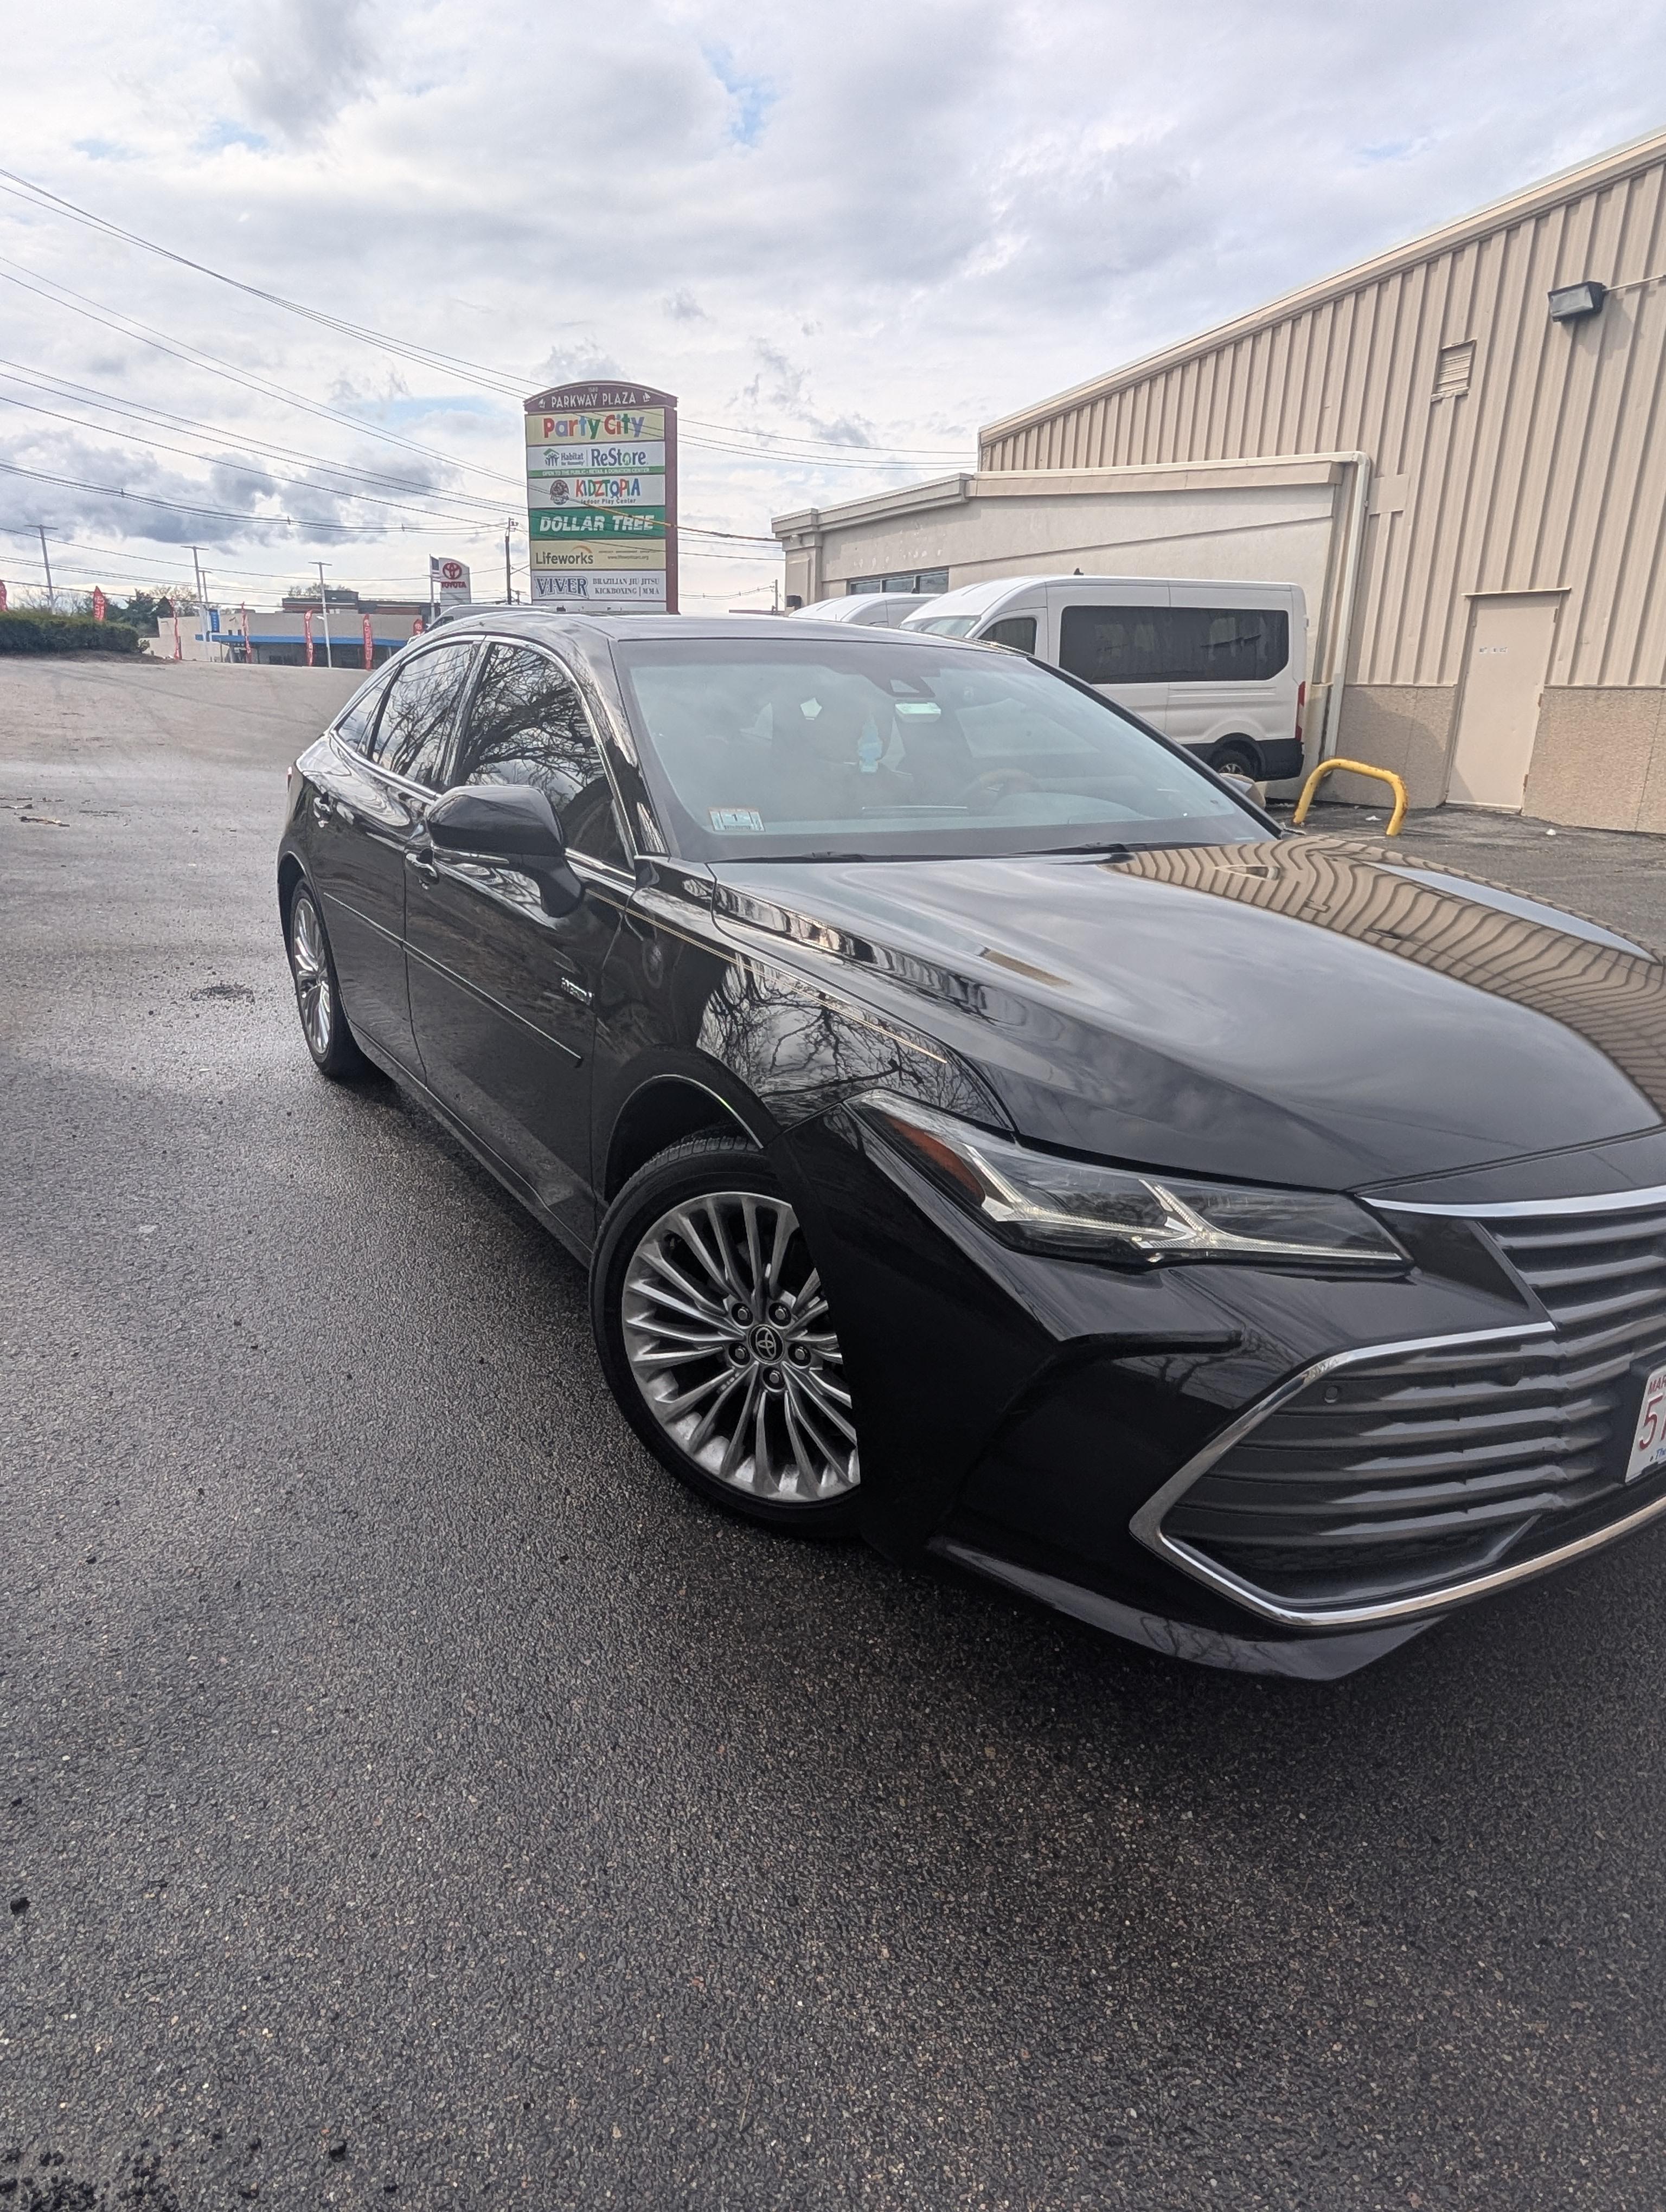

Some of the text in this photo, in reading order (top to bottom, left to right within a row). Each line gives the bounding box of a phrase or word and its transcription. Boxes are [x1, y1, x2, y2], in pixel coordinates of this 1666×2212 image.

[552, 392, 636, 408] PARKWAY PLAZA
[543, 414, 644, 439] Party City
[561, 453, 584, 461] Habitat
[591, 448, 646, 466] ReStore
[576, 478, 640, 498] KIDZTOPIA
[540, 515, 655, 531] DOLLAR TREE
[536, 551, 593, 564] Lifeworks
[536, 577, 588, 597] VIVER
